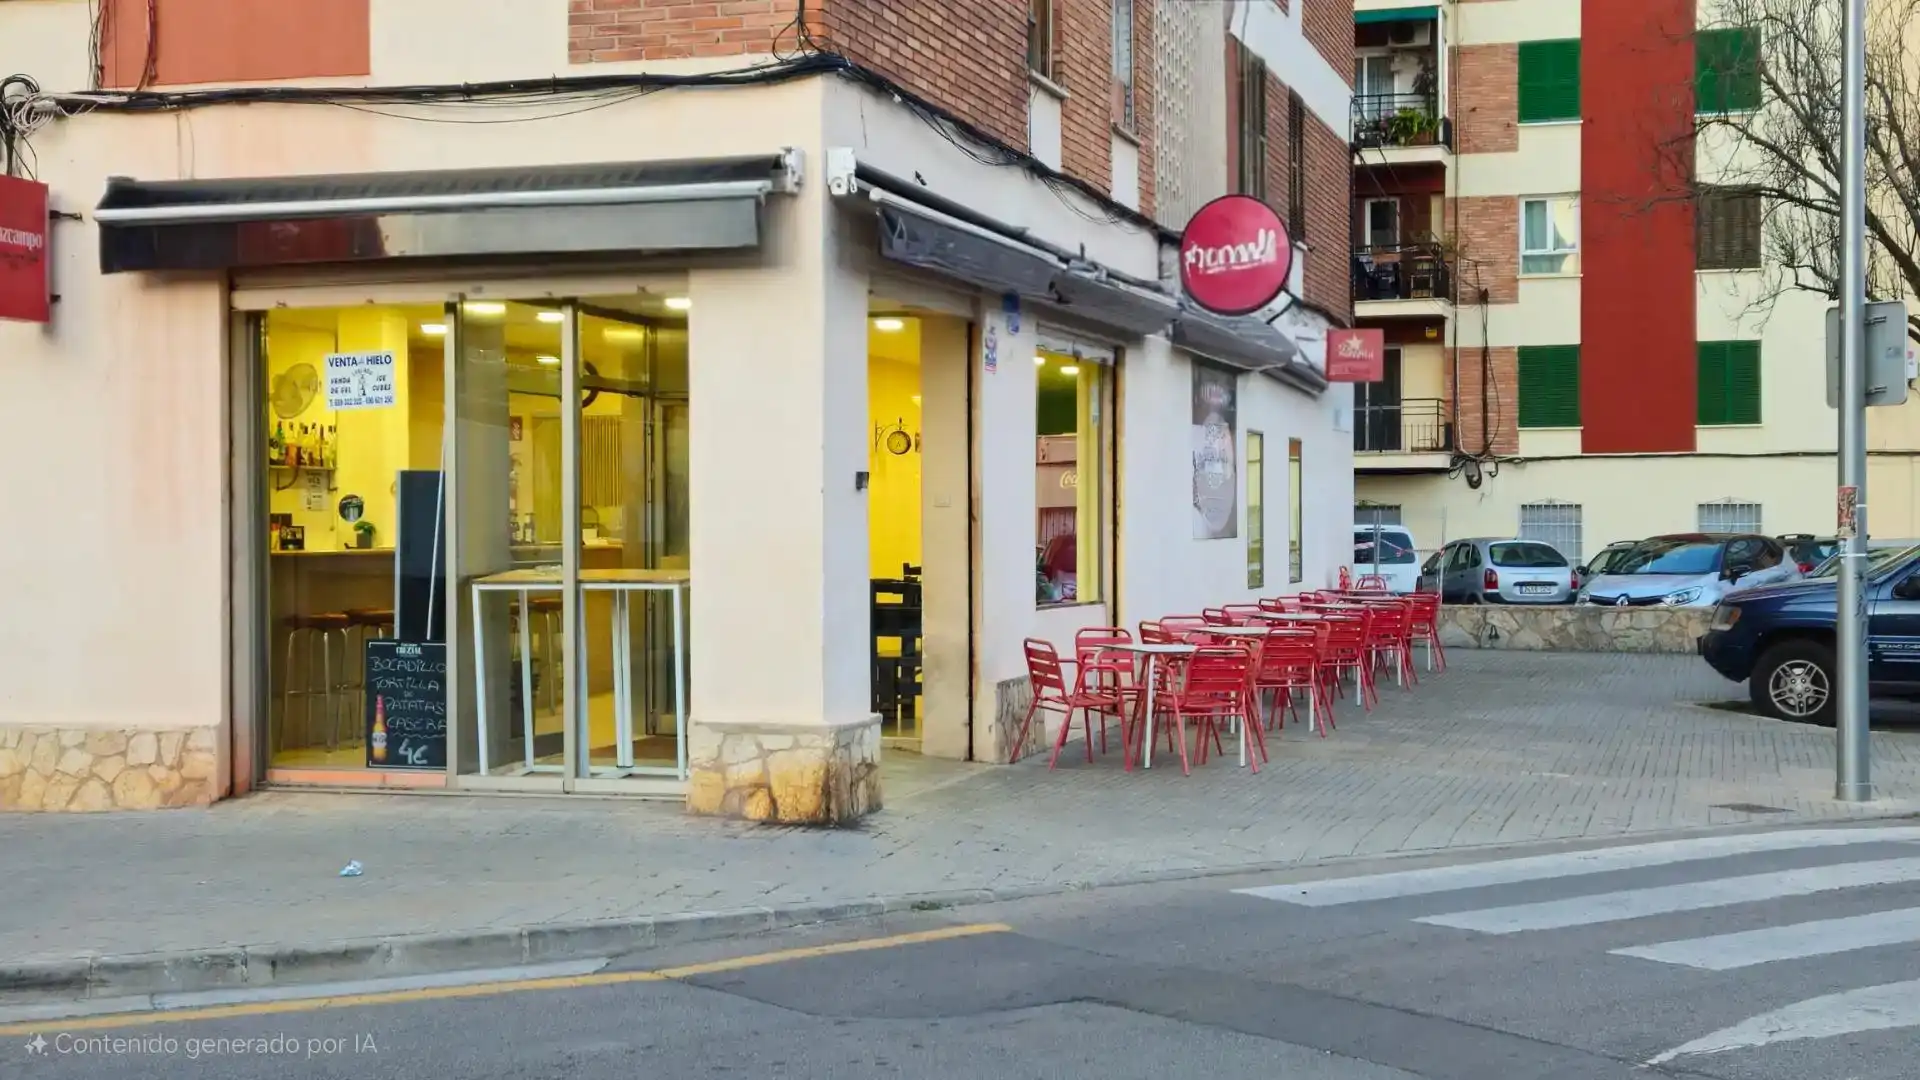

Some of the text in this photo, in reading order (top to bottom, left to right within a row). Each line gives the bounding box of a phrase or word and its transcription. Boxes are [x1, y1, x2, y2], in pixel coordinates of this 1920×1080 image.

[0, 226, 42, 251] zcampo
[328, 355, 392, 367] VENTA HIELO
[369, 656, 448, 673] BOCADILLO
[372, 676, 439, 692] TORTILLA
[384, 696, 445, 715] PATATAS
